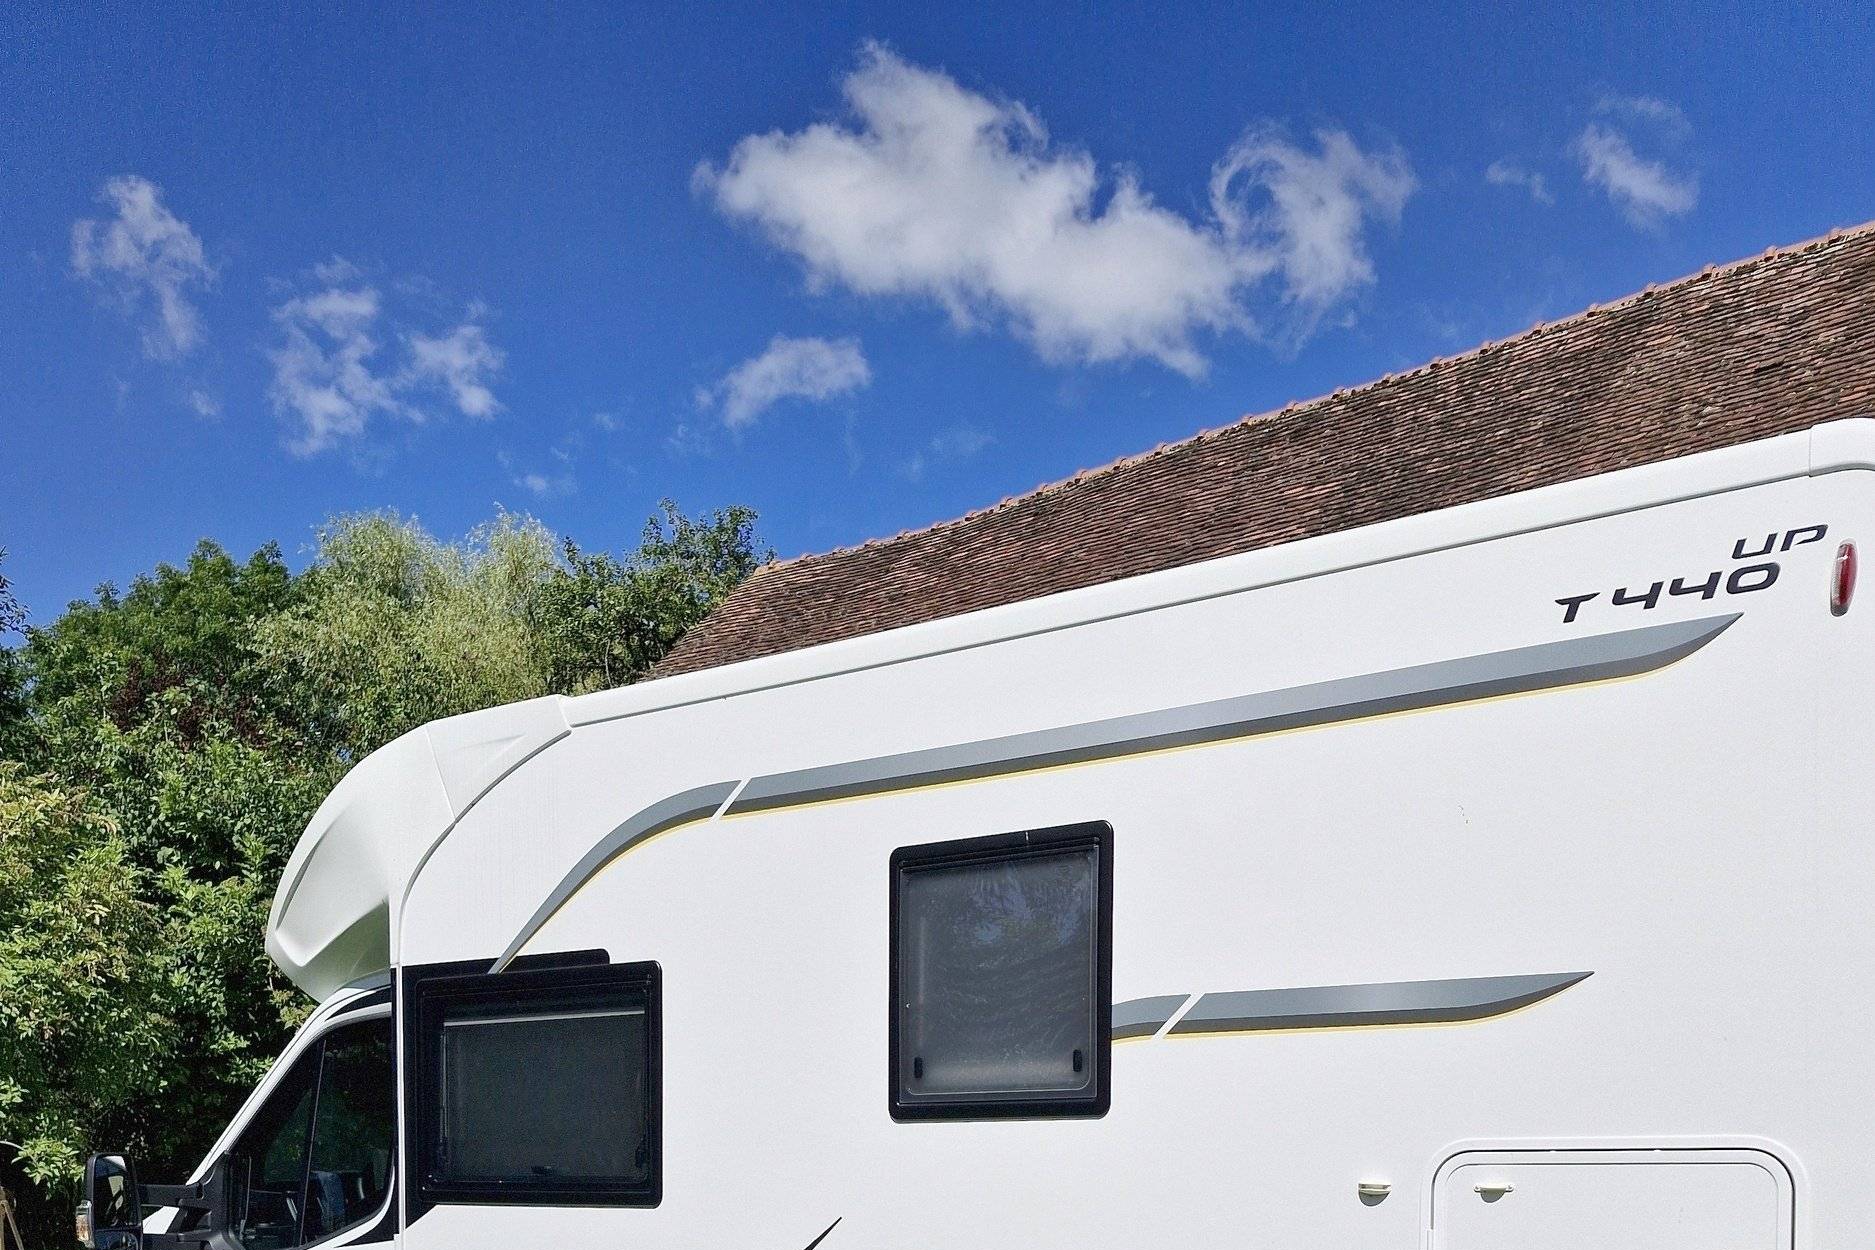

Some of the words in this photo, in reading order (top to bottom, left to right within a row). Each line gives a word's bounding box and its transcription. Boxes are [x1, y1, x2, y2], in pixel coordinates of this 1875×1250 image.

[1731, 524, 1829, 560] UP
[1554, 592, 1601, 624] T
[1611, 562, 1781, 610] 440
